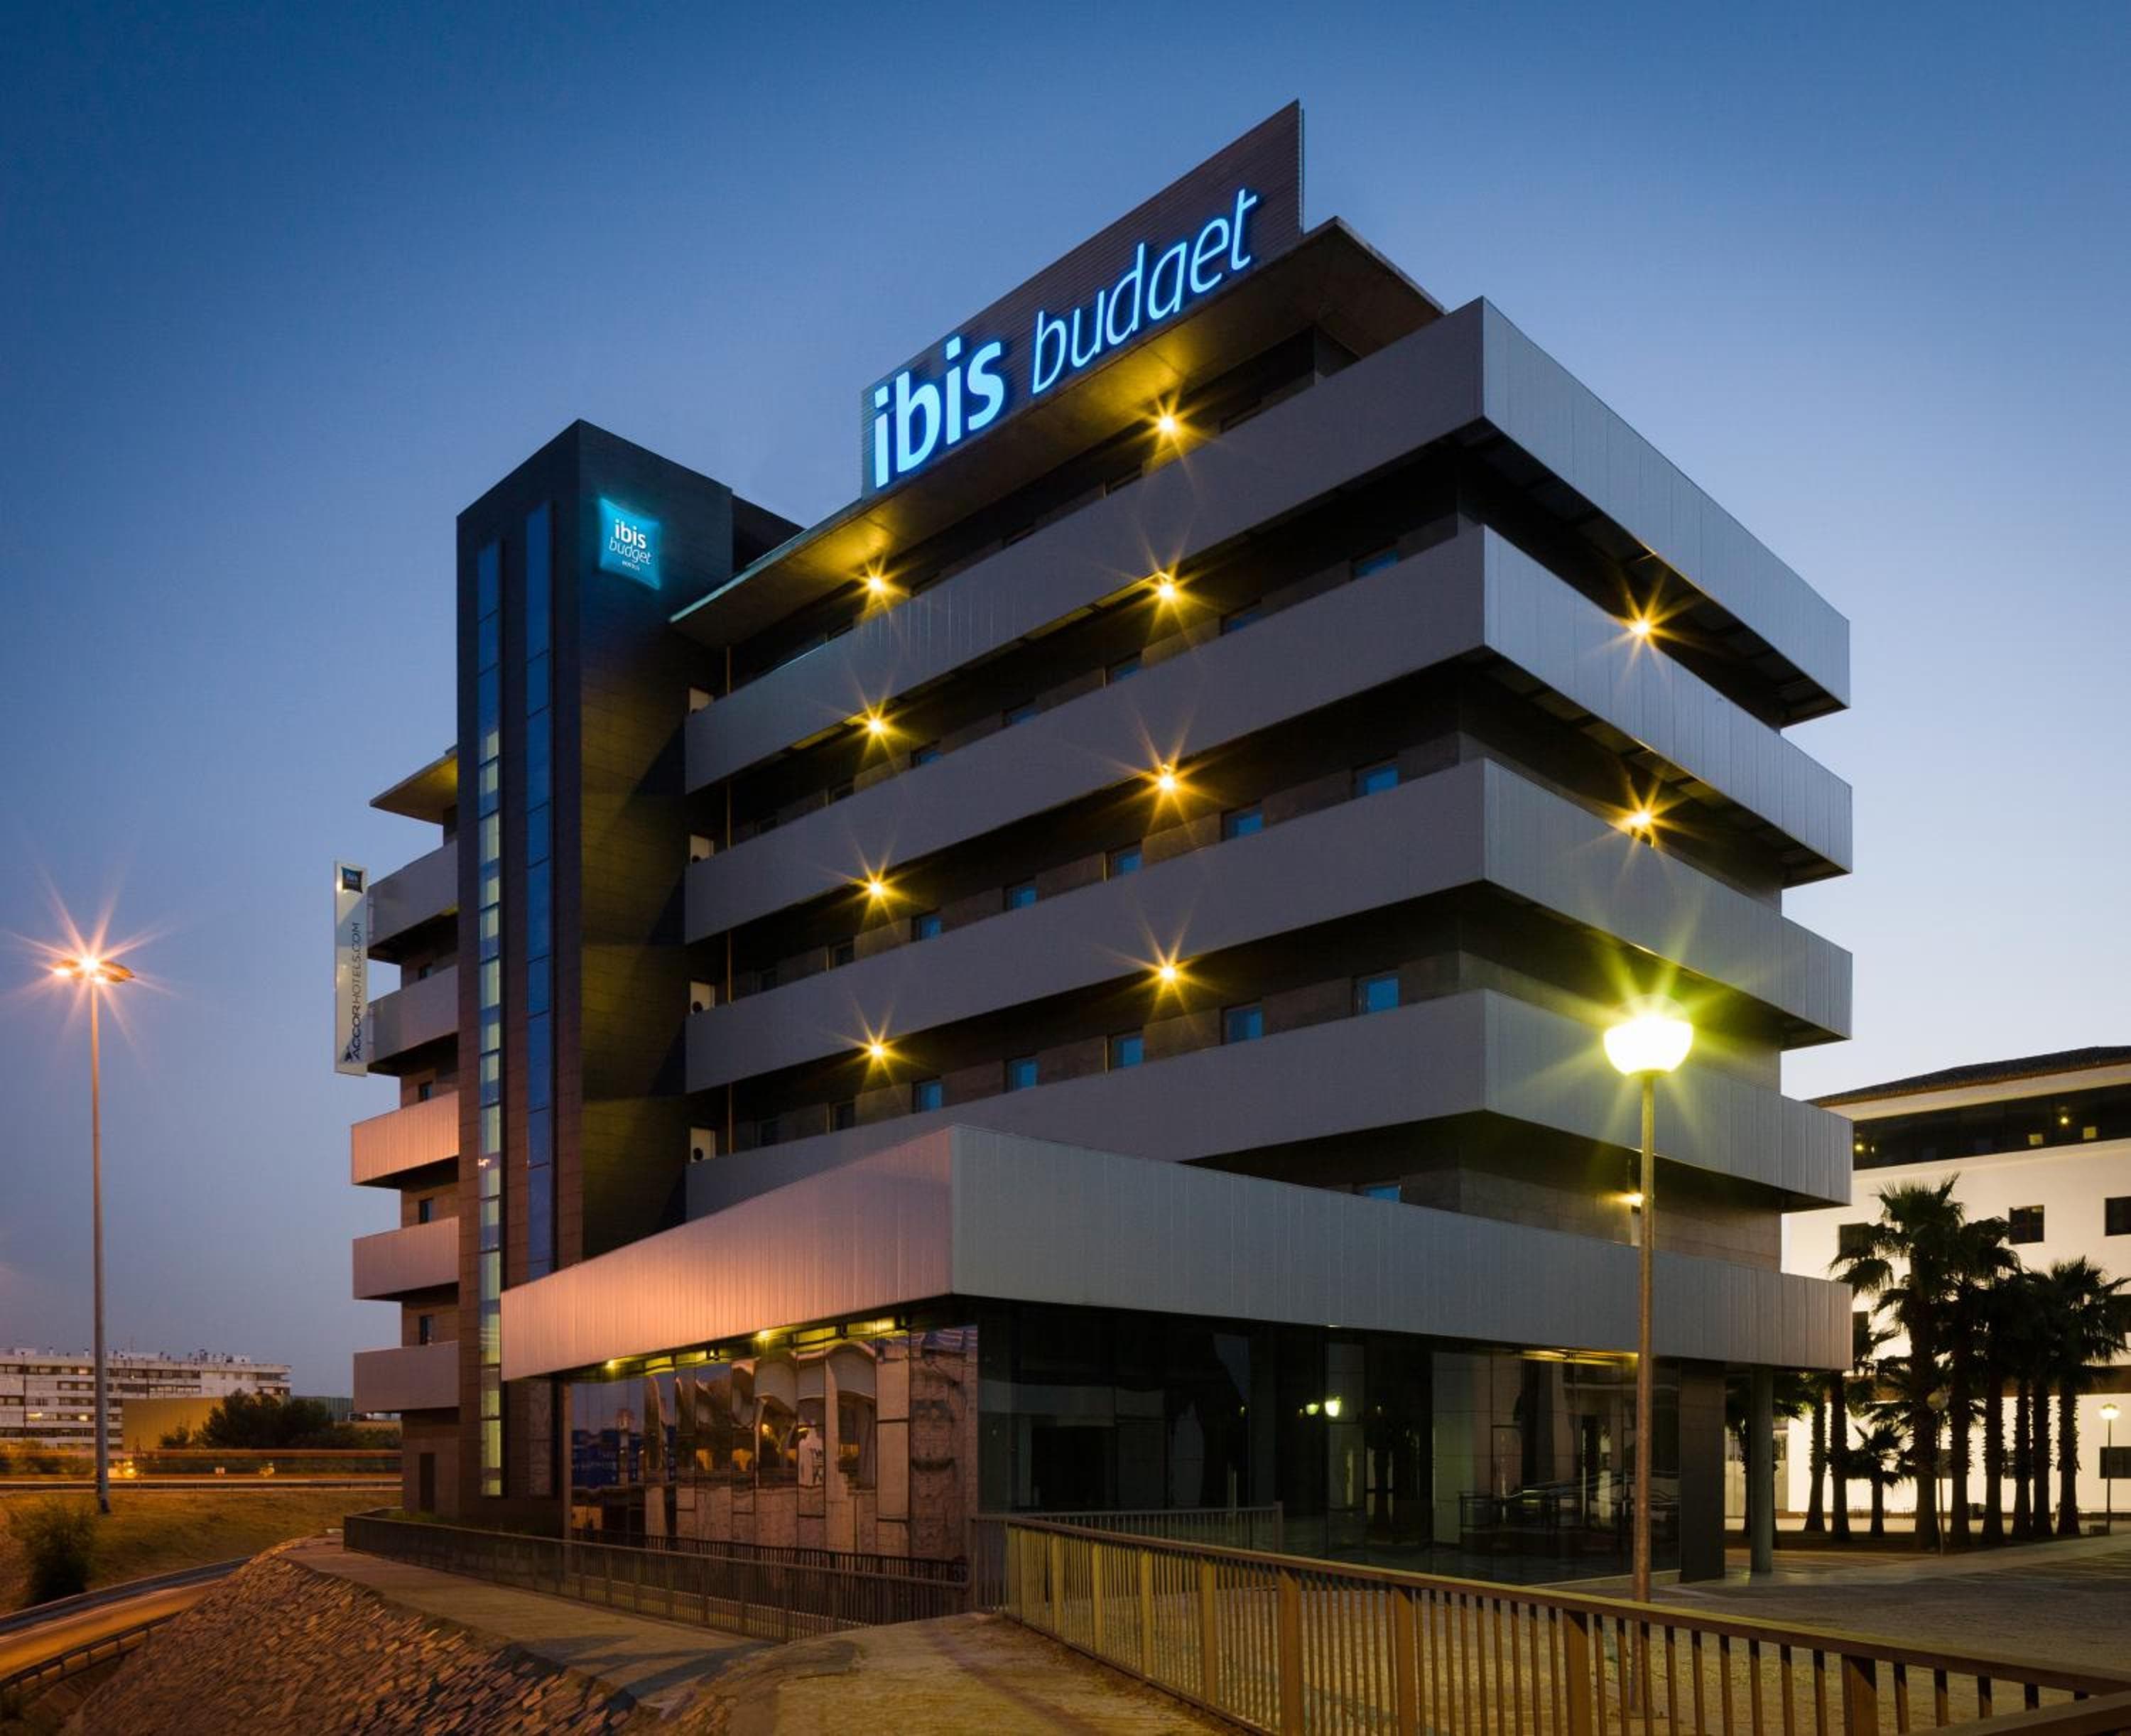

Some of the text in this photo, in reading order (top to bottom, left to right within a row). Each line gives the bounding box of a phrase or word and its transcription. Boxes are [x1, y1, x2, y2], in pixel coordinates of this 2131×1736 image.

[874, 337, 1004, 489] ibis
[614, 519, 647, 549] ibis
[609, 536, 651, 565] budget
